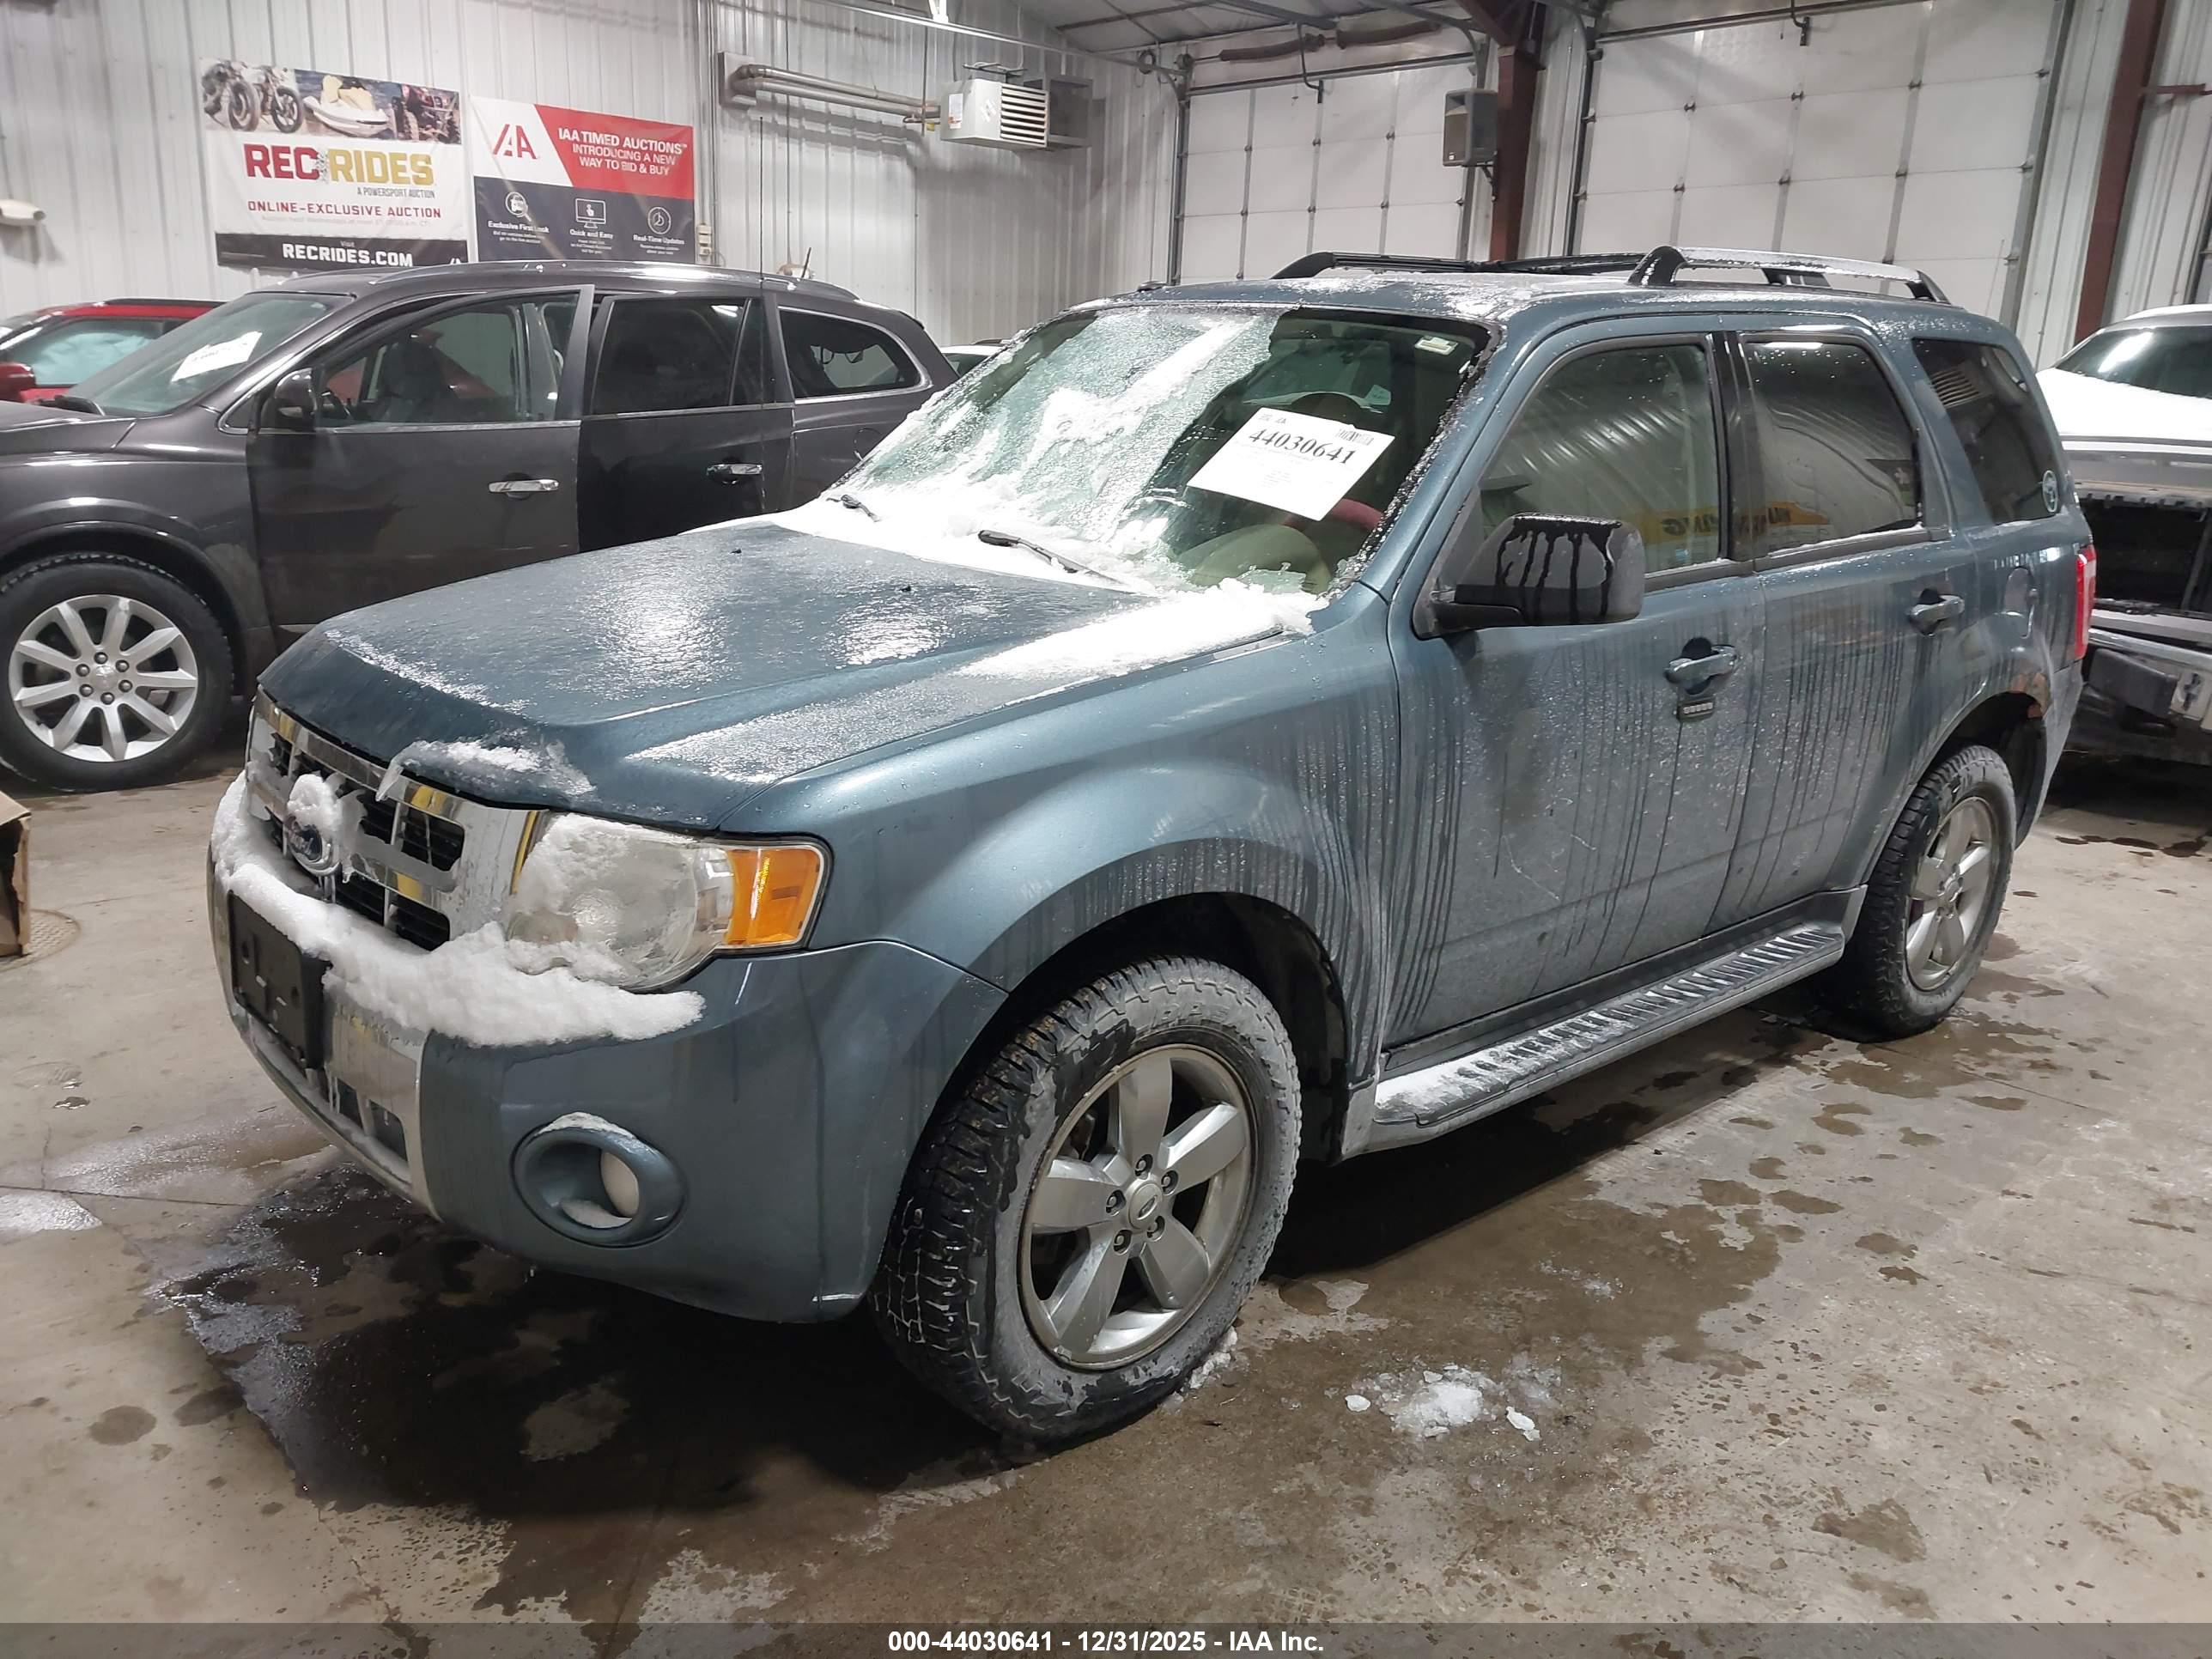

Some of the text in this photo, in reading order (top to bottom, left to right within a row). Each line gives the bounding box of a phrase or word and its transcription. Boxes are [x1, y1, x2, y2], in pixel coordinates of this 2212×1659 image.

[558, 128, 580, 142] IAA
[580, 131, 620, 146] TIMED
[243, 143, 434, 186] REC RIDES
[573, 144, 676, 165] INTRODUCING A NEW
[580, 156, 670, 175] WAY TO BID & BUY
[357, 187, 435, 198] A POWERSPORT AUCTION
[247, 200, 441, 218] ONLINE-EXCLUSIVE AUCTION
[282, 243, 414, 267] RECRIDES.COM
[1248, 428, 1357, 465] 44030641
